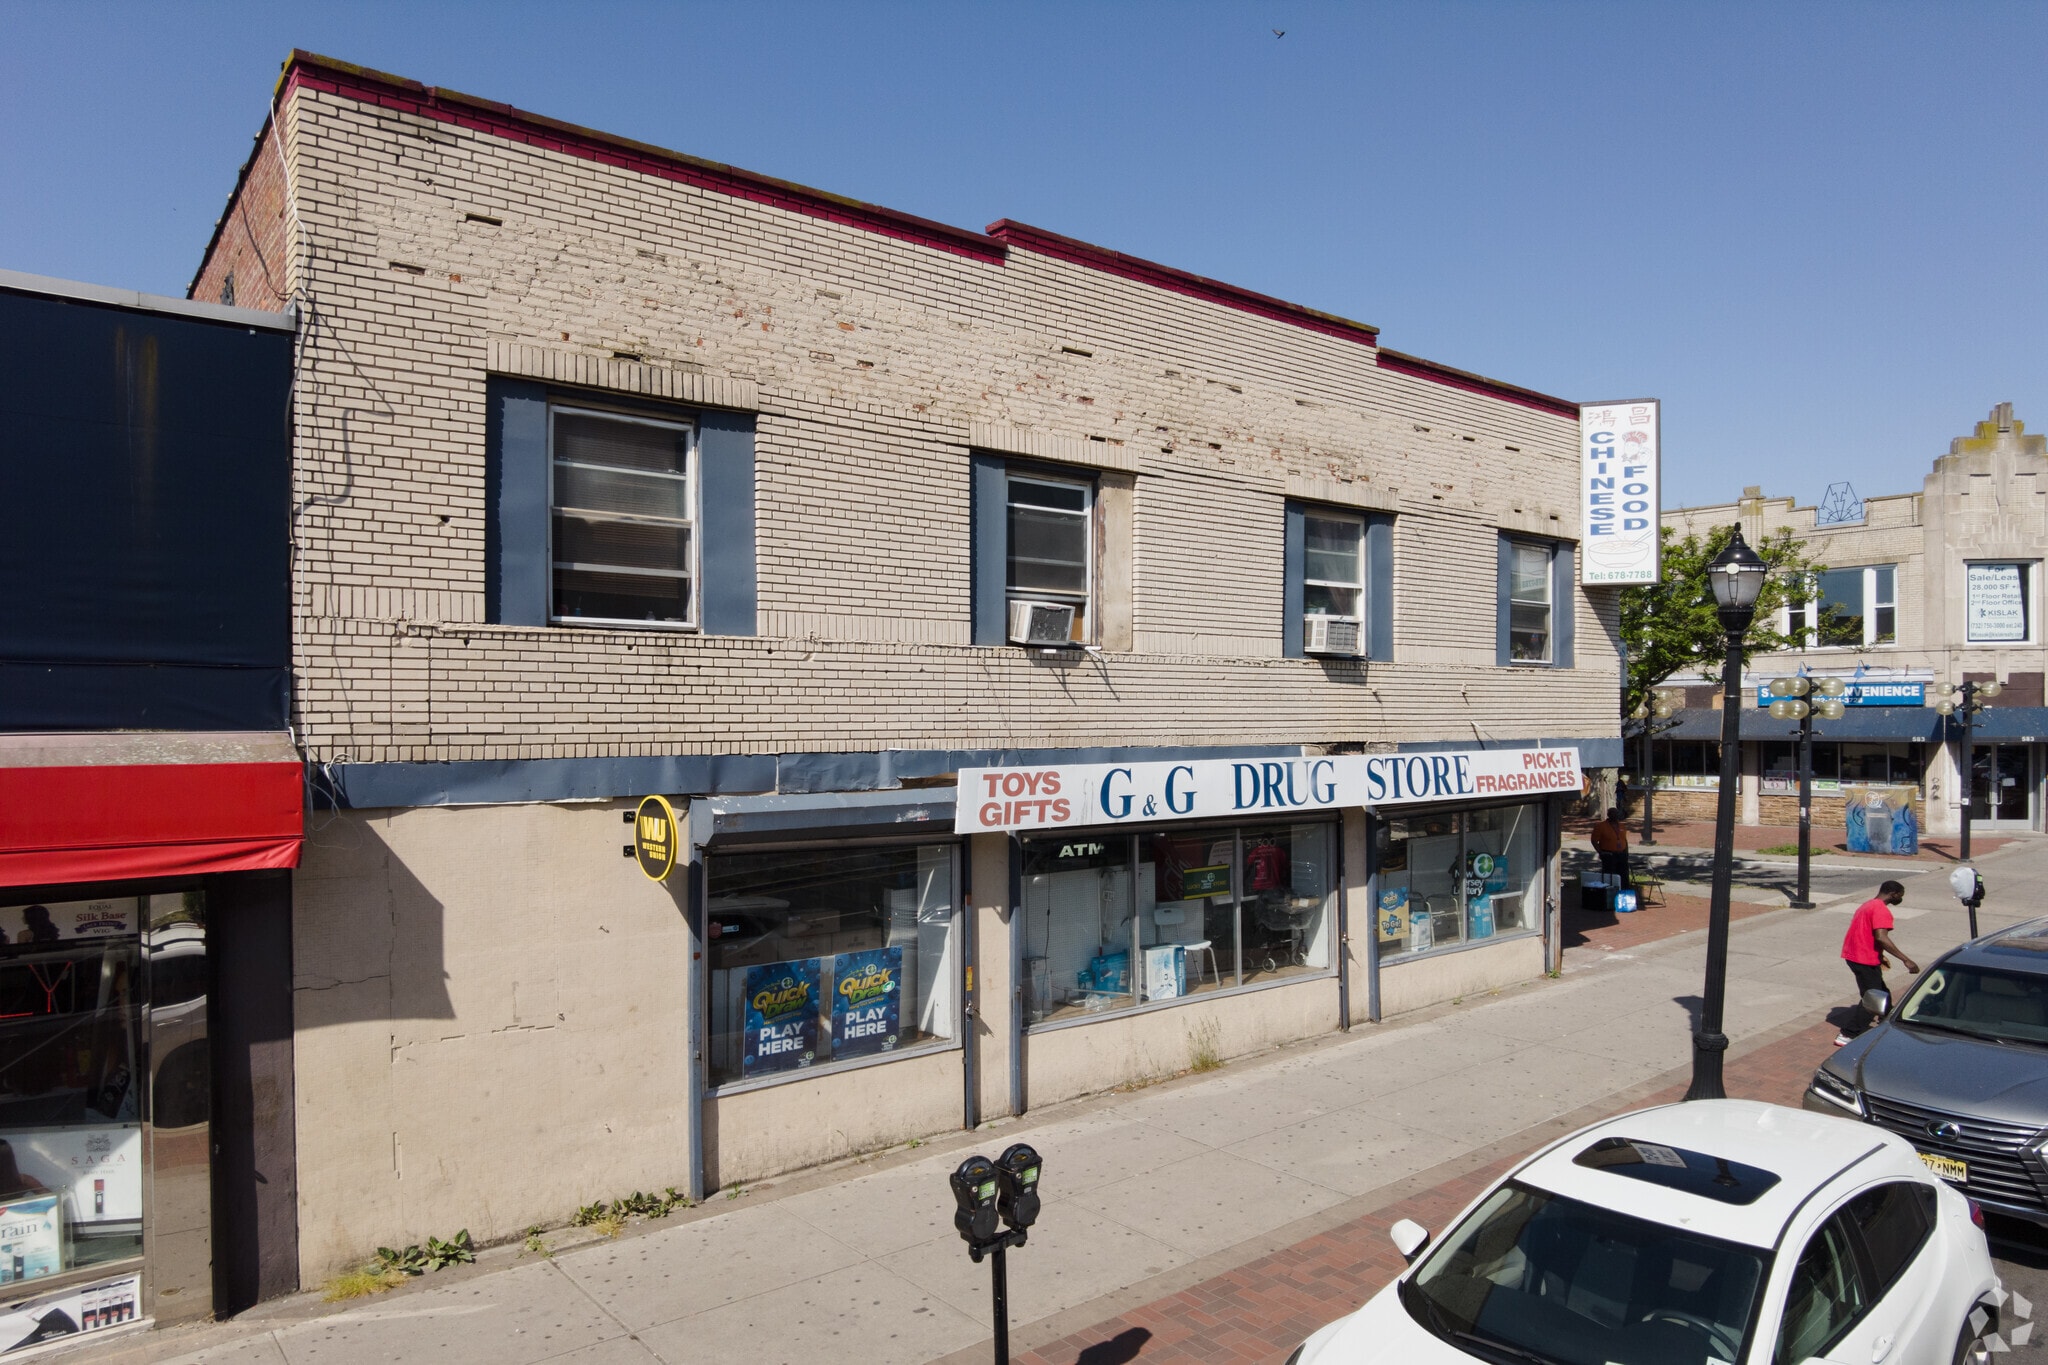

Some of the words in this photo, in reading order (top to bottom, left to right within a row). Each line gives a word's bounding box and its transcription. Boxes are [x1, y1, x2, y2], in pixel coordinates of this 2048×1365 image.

[1590, 431, 1615, 536] CHINESE
[1622, 465, 1649, 530] FOOD
[1589, 572, 1606, 580] Tel:
[1608, 570, 1653, 580] 678-7788
[1522, 752, 1573, 770] PICK-IT
[983, 771, 1061, 798] TOYS
[1100, 768, 1136, 819] G
[1142, 794, 1158, 817] &
[1165, 765, 1198, 814] G
[1231, 759, 1338, 809] DRUG
[1367, 755, 1474, 801] STORE
[1476, 770, 1576, 793] FRAGRANCES
[979, 798, 1071, 827] GIFTS
[640, 816, 667, 843] WU
[642, 842, 666, 853] WESTERN
[649, 850, 666, 861] UNION
[1059, 843, 1104, 858] ATM
[1454, 869, 1474, 879] Nw
[76, 913, 99, 922] Silk
[101, 911, 126, 920] Base
[839, 968, 893, 999] Quick
[753, 981, 811, 1014] Quick
[765, 997, 807, 1020] Draw
[845, 1006, 887, 1025] PLAY
[760, 1022, 805, 1041] PLAY
[844, 1020, 887, 1040] HERE
[758, 1036, 804, 1057] HERE
[71, 1153, 126, 1166] SAGA
[1943, 1162, 1964, 1178] NMM
